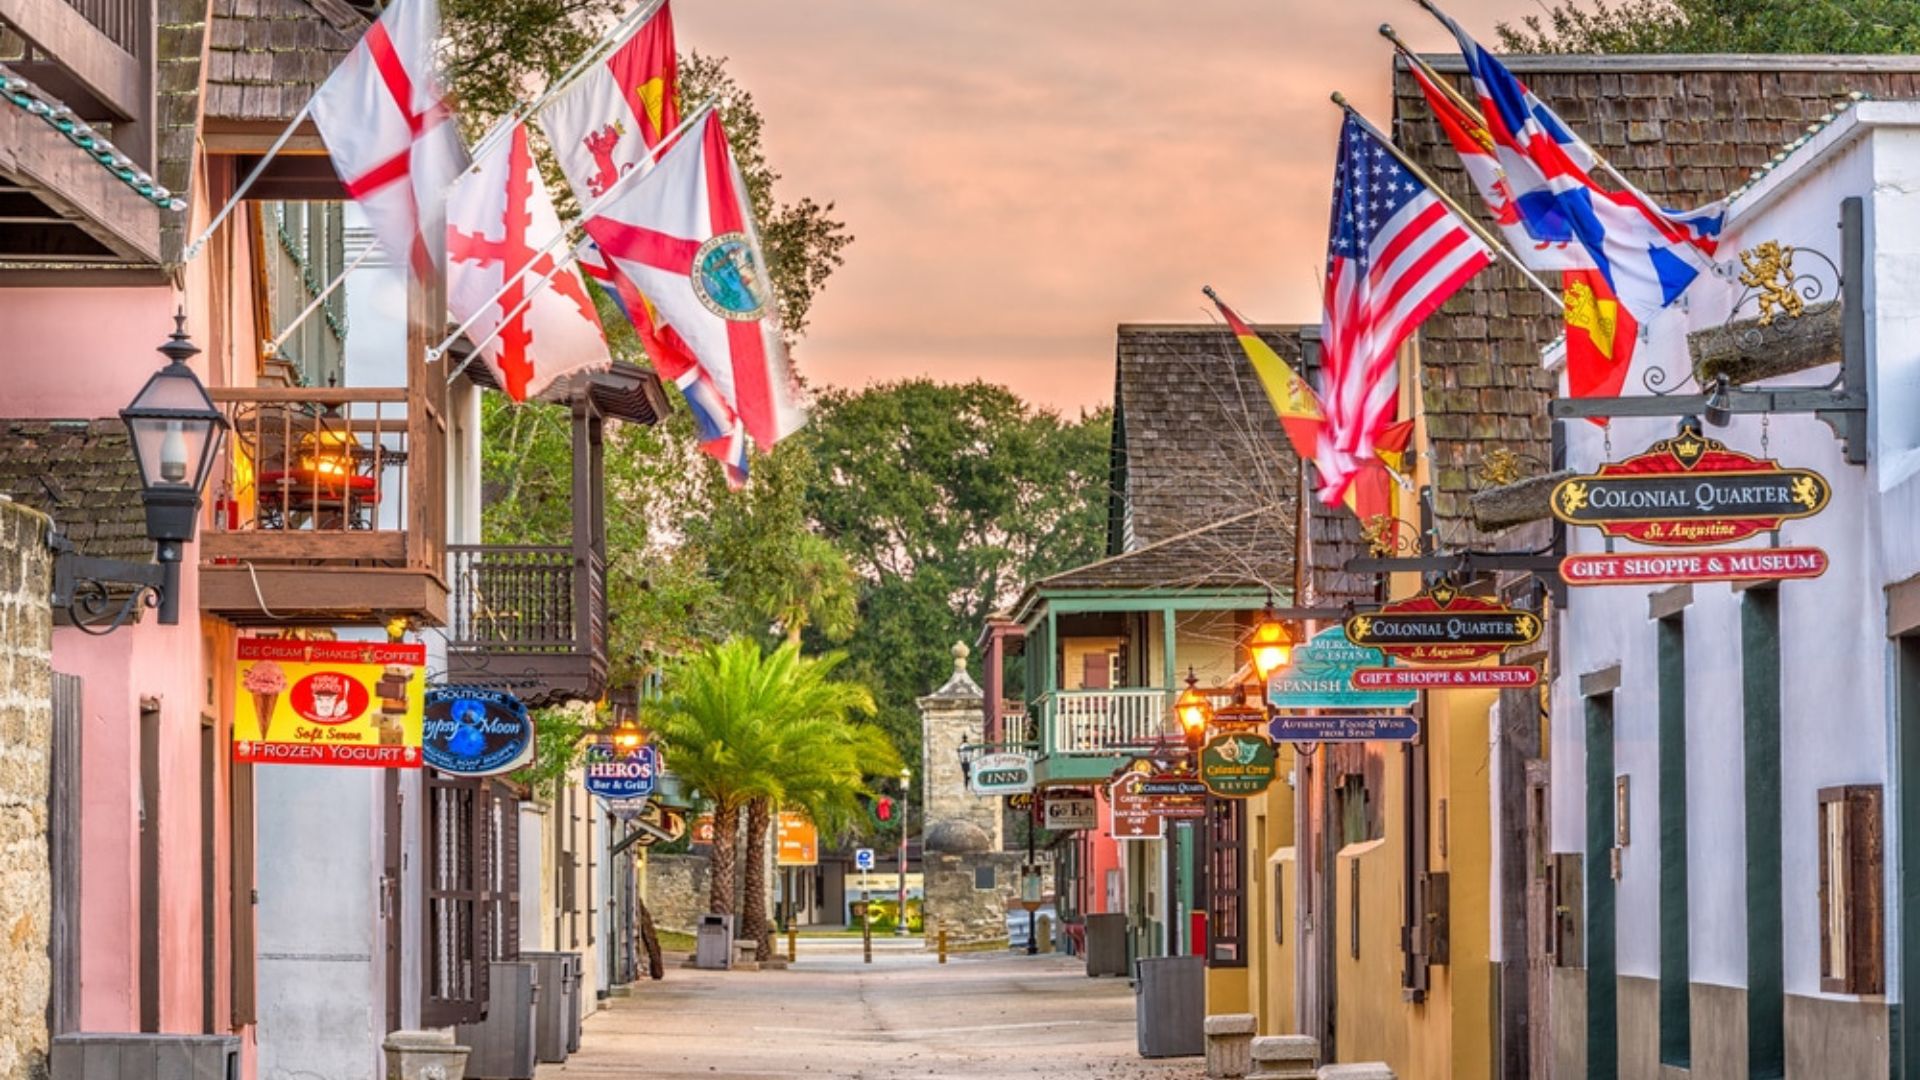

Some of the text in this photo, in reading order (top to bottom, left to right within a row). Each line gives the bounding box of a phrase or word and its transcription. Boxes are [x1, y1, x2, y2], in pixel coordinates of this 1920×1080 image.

[1589, 482, 1790, 511] COLONIAL QUARTER
[1644, 521, 1736, 539] St. Augustine
[1572, 554, 1817, 576] GIFT SHOPPE & MUSEUM
[1372, 618, 1514, 638] COLONIAL QUARTER
[241, 644, 419, 662] ICE CREAM SHAKES COFFEE
[1429, 646, 1475, 658] Augustine
[1360, 670, 1531, 684] GIFT SHOPPE & MUSEUM
[1273, 680, 1341, 692] SPANISH
[437, 690, 502, 702] BOUTIQUE
[480, 717, 521, 734] Moon
[1282, 719, 1336, 729] AUTHENTIC
[1378, 719, 1405, 729] WINE
[294, 727, 362, 742] Soft Serve
[1319, 729, 1375, 738] FROM SPAIN
[252, 744, 400, 761] FROZEN YOGURT
[590, 763, 651, 778] HEROS
[593, 780, 648, 789] Bar & Grill
[987, 772, 1019, 784] INN
[1220, 782, 1259, 790] REVUE
